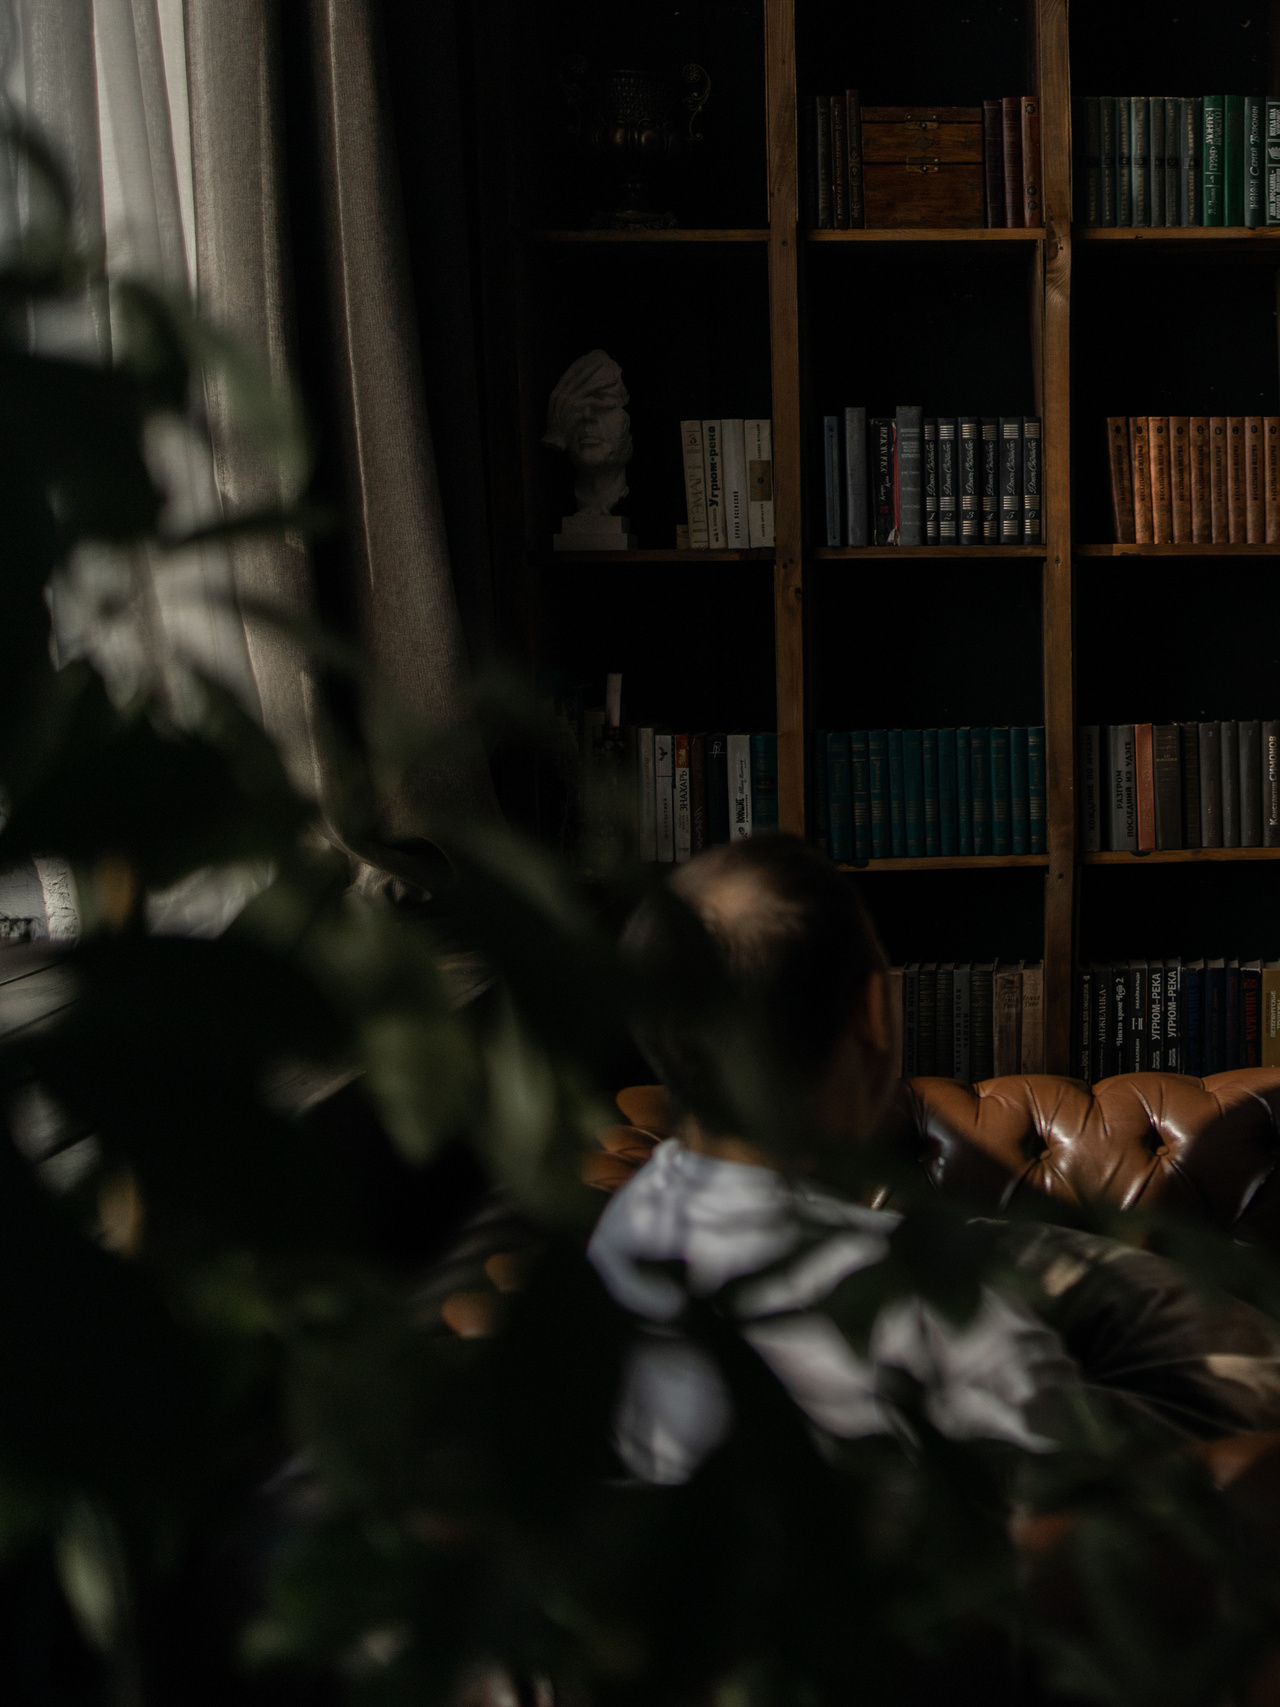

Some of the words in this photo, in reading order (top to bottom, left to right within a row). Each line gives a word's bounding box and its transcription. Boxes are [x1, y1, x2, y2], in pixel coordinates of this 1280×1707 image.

[1086, 734, 1094, 764] МУКАМ
[1125, 741, 1133, 767] УДЭГЕ
[1268, 735, 1278, 781] СИМОНОВ
[679, 769, 688, 812] ЗНАХАРЬ
[1088, 767, 1094, 780] ПО
[1116, 770, 1124, 810] РАЗГРОМ
[1126, 771, 1133, 783] ИЗ
[1088, 784, 1096, 832] ХОЖДЕНИЕ
[1126, 787, 1134, 838] ПОСЛЕДНИЙ
[1269, 782, 1279, 826] Константин
[907, 976, 915, 1008] МУКАМ
[1117, 1002, 1125, 1020] кроме
[1151, 973, 1161, 1041] УГРЮМ-РЕКА
[1167, 970, 1177, 1038] УГРЮМ-РЕКА
[907, 1011, 915, 1023] ПО
[1098, 989, 1107, 1043] АНЖЕЛИКА
[1115, 1022, 1124, 1047] Никто
[907, 1028, 915, 1074] ХОЖДЕНИЕ
